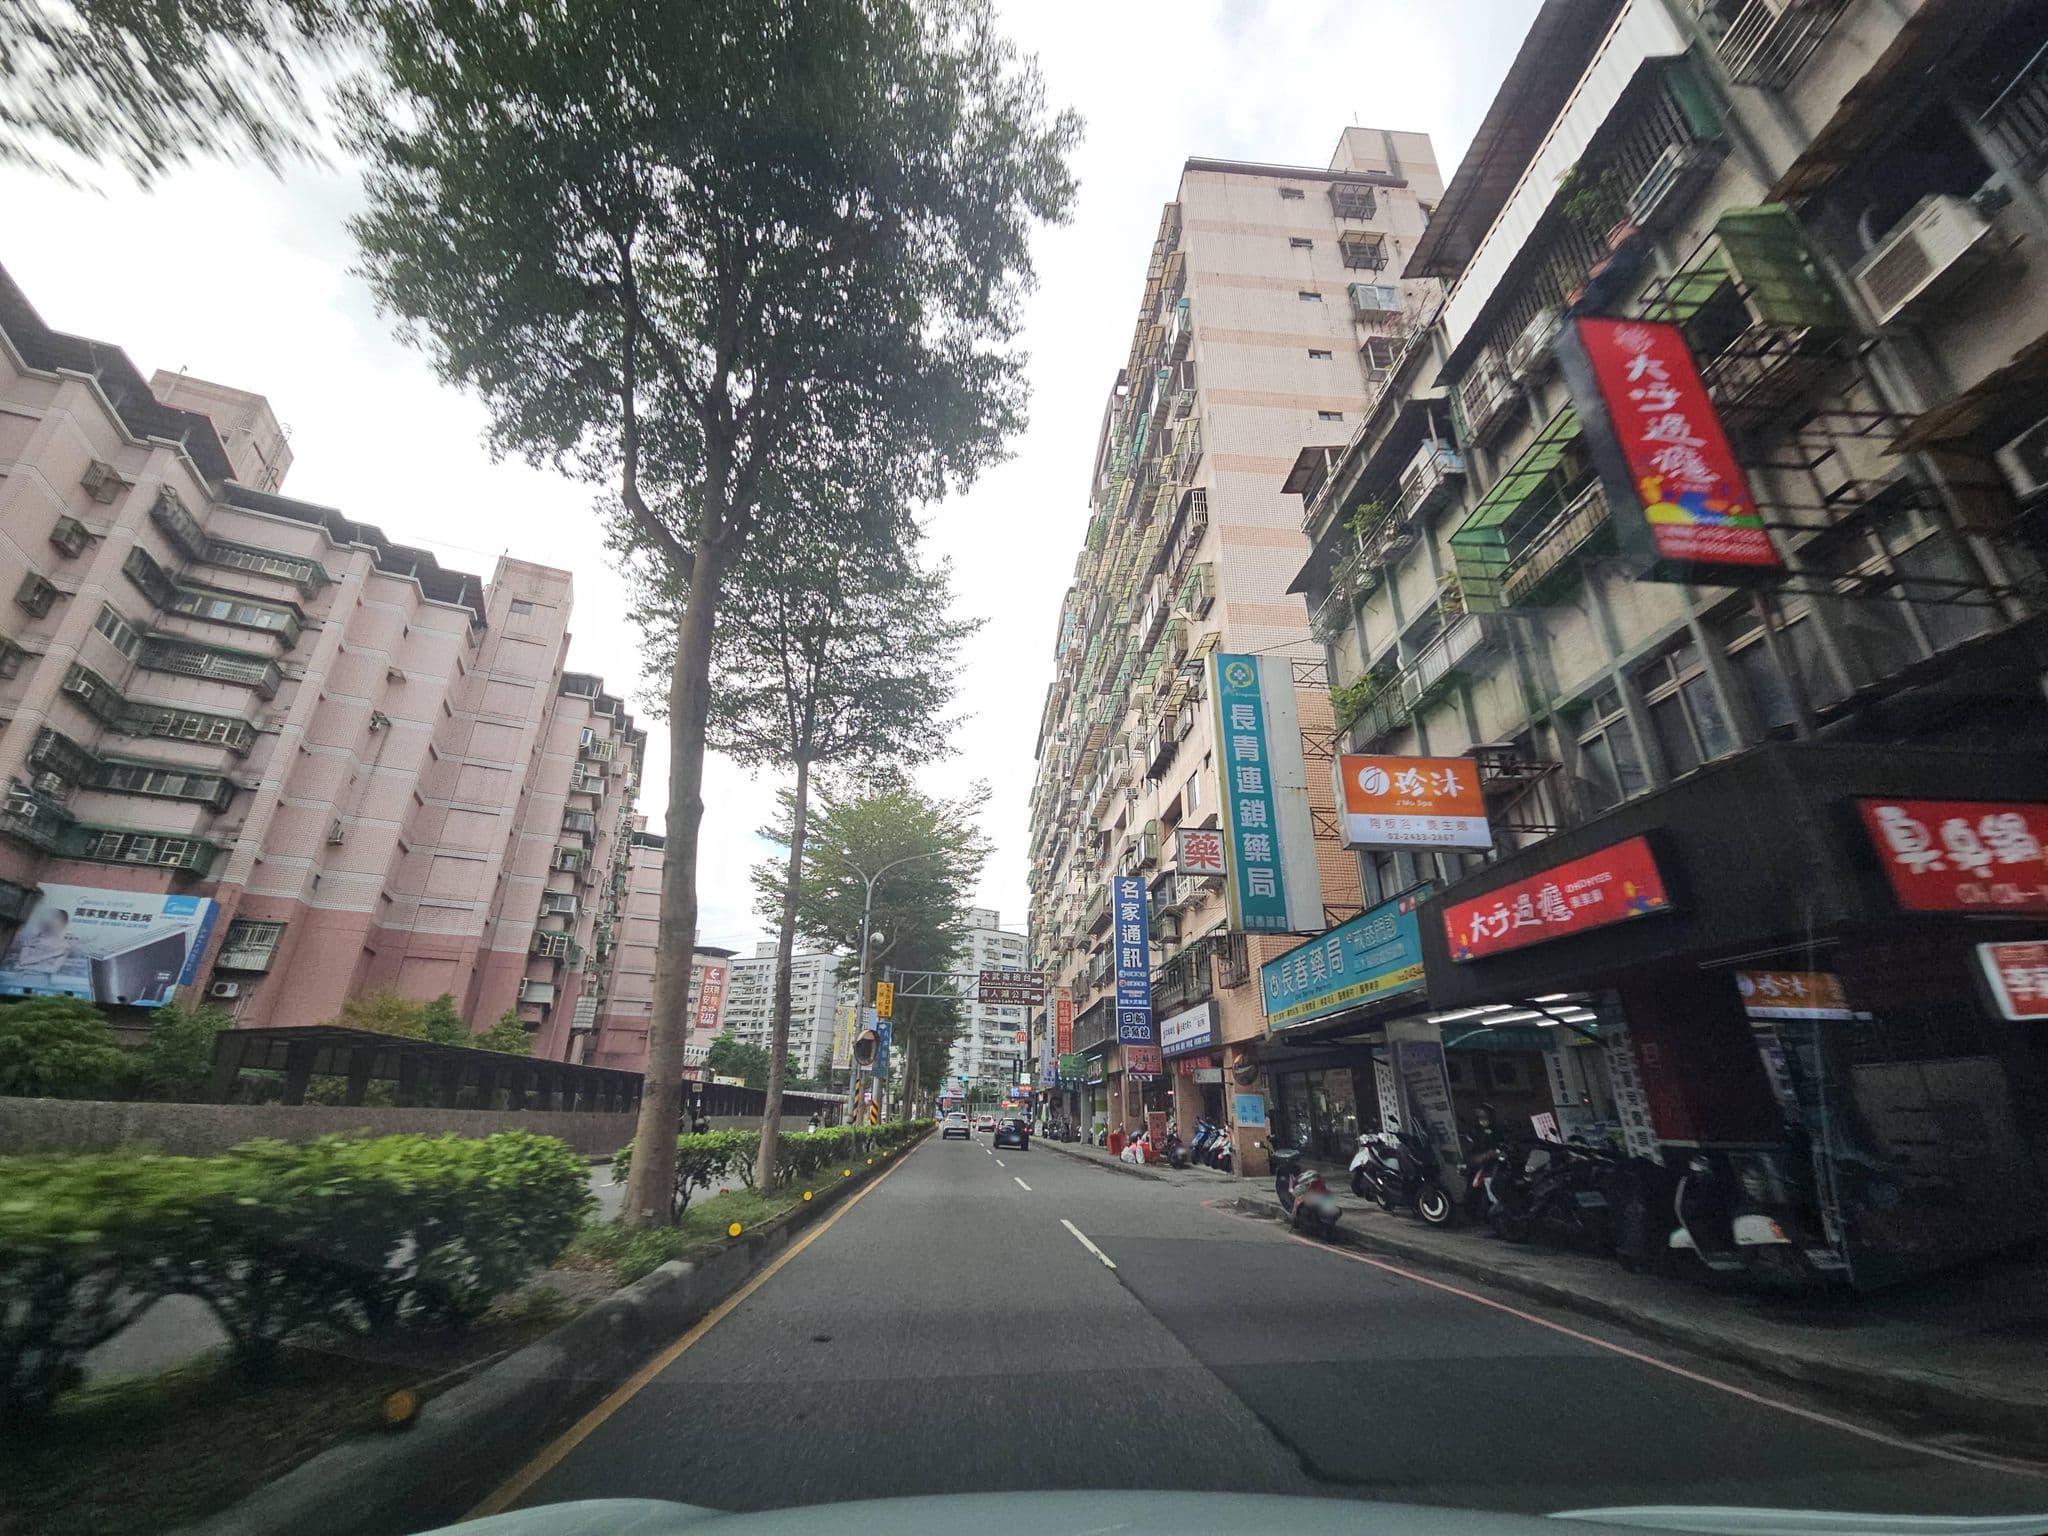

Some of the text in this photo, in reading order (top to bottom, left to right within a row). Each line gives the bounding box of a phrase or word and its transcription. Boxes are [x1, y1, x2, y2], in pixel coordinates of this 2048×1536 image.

[1230, 703, 1276, 898] 長青連鎖藥局
[1393, 767, 1465, 798] 珍沐
[1183, 833, 1221, 870] 藥
[1121, 880, 1142, 968] 名家通訊
[1470, 882, 1575, 944] 大呼過癮
